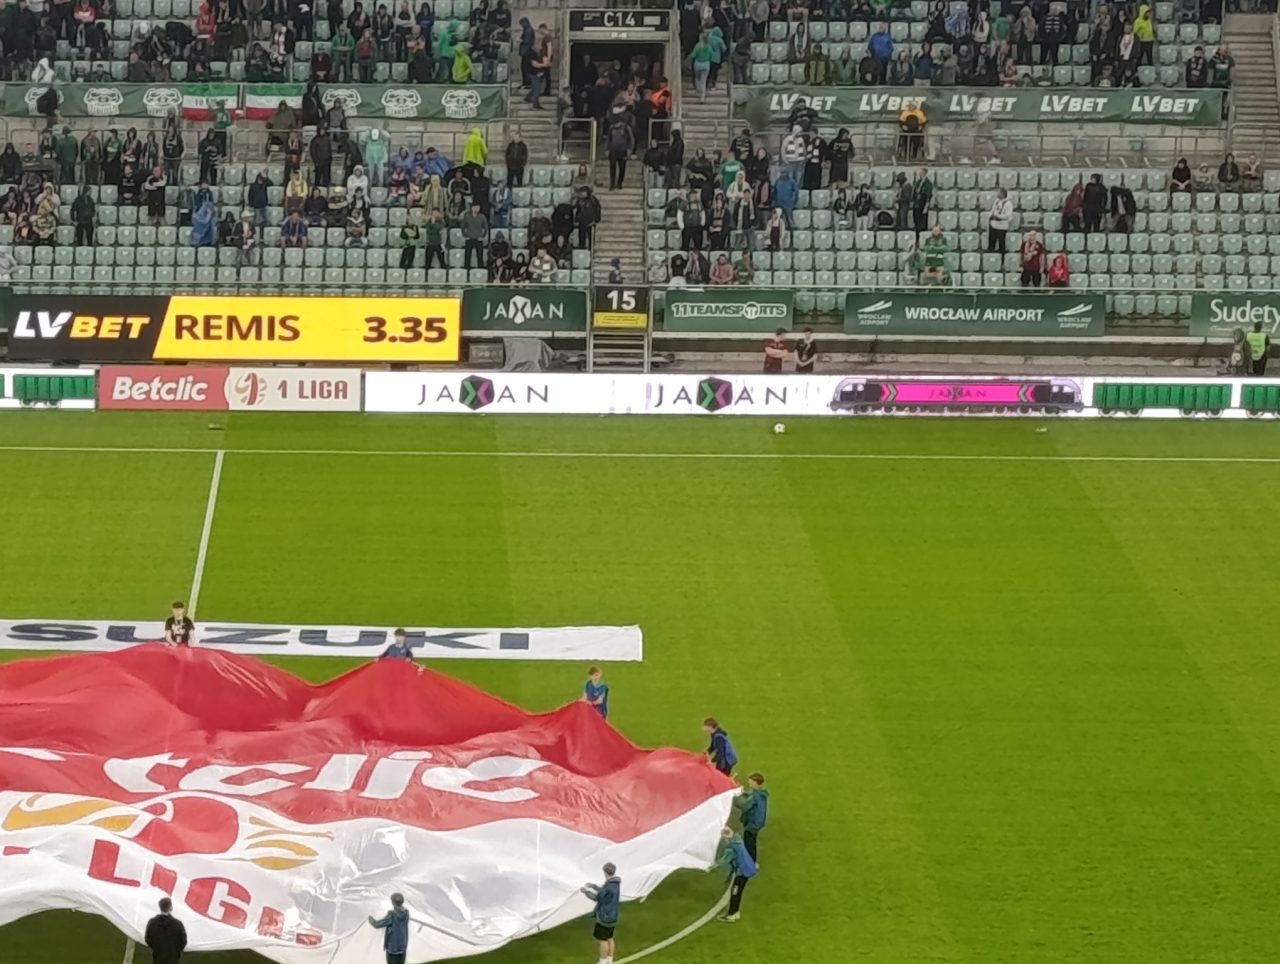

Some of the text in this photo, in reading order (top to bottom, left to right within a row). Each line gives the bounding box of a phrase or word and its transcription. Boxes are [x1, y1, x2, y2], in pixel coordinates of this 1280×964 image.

[604, 12, 635, 26] C14
[482, 295, 563, 324] JAXAN
[607, 290, 636, 311] 15
[905, 307, 1045, 321] WROCŁAW AIRPORT
[175, 314, 448, 343] REMIS 3.35
[112, 374, 209, 402] Betclic
[276, 380, 348, 400] 1 LIGA
[418, 374, 549, 411] JAXAN
[654, 376, 787, 412] JAXAN
[6, 623, 529, 650] SUZUKI
